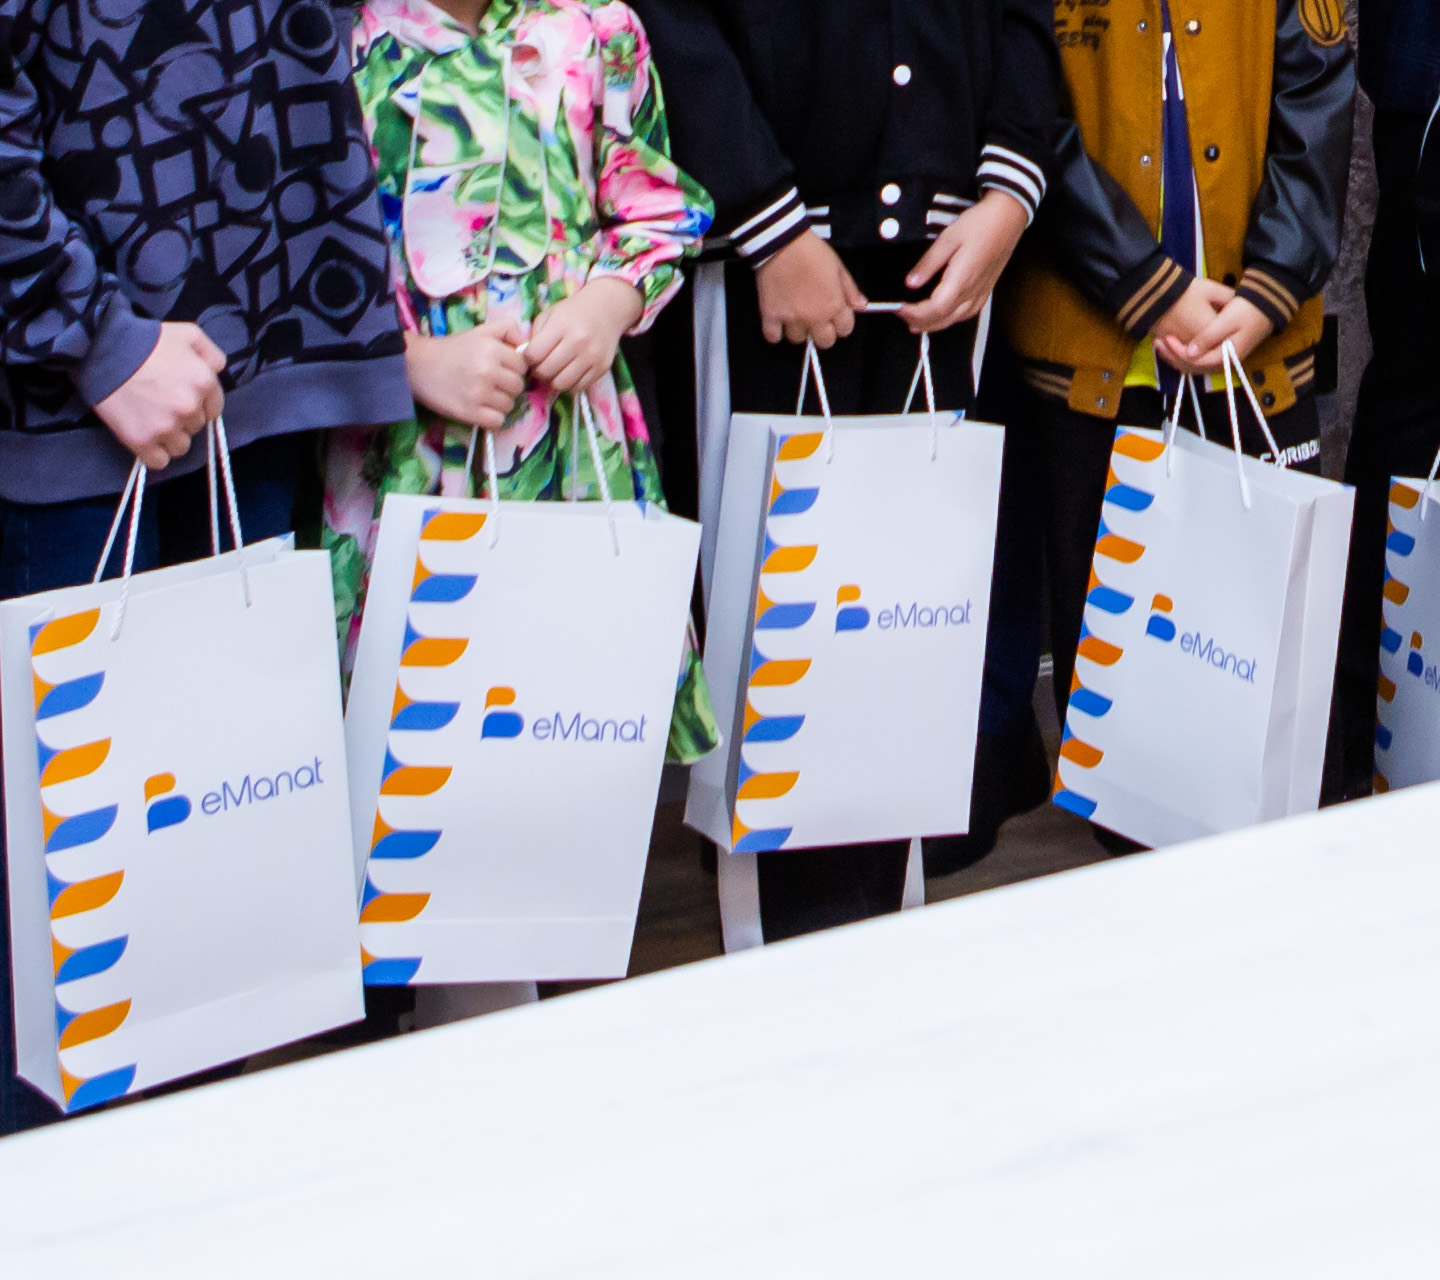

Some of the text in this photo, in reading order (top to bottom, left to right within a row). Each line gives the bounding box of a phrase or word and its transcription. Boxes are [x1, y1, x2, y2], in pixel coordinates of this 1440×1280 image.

[877, 598, 972, 631] eManat
[1180, 628, 1258, 684] eManat
[531, 712, 647, 743] eManat
[200, 756, 324, 816] eManat
